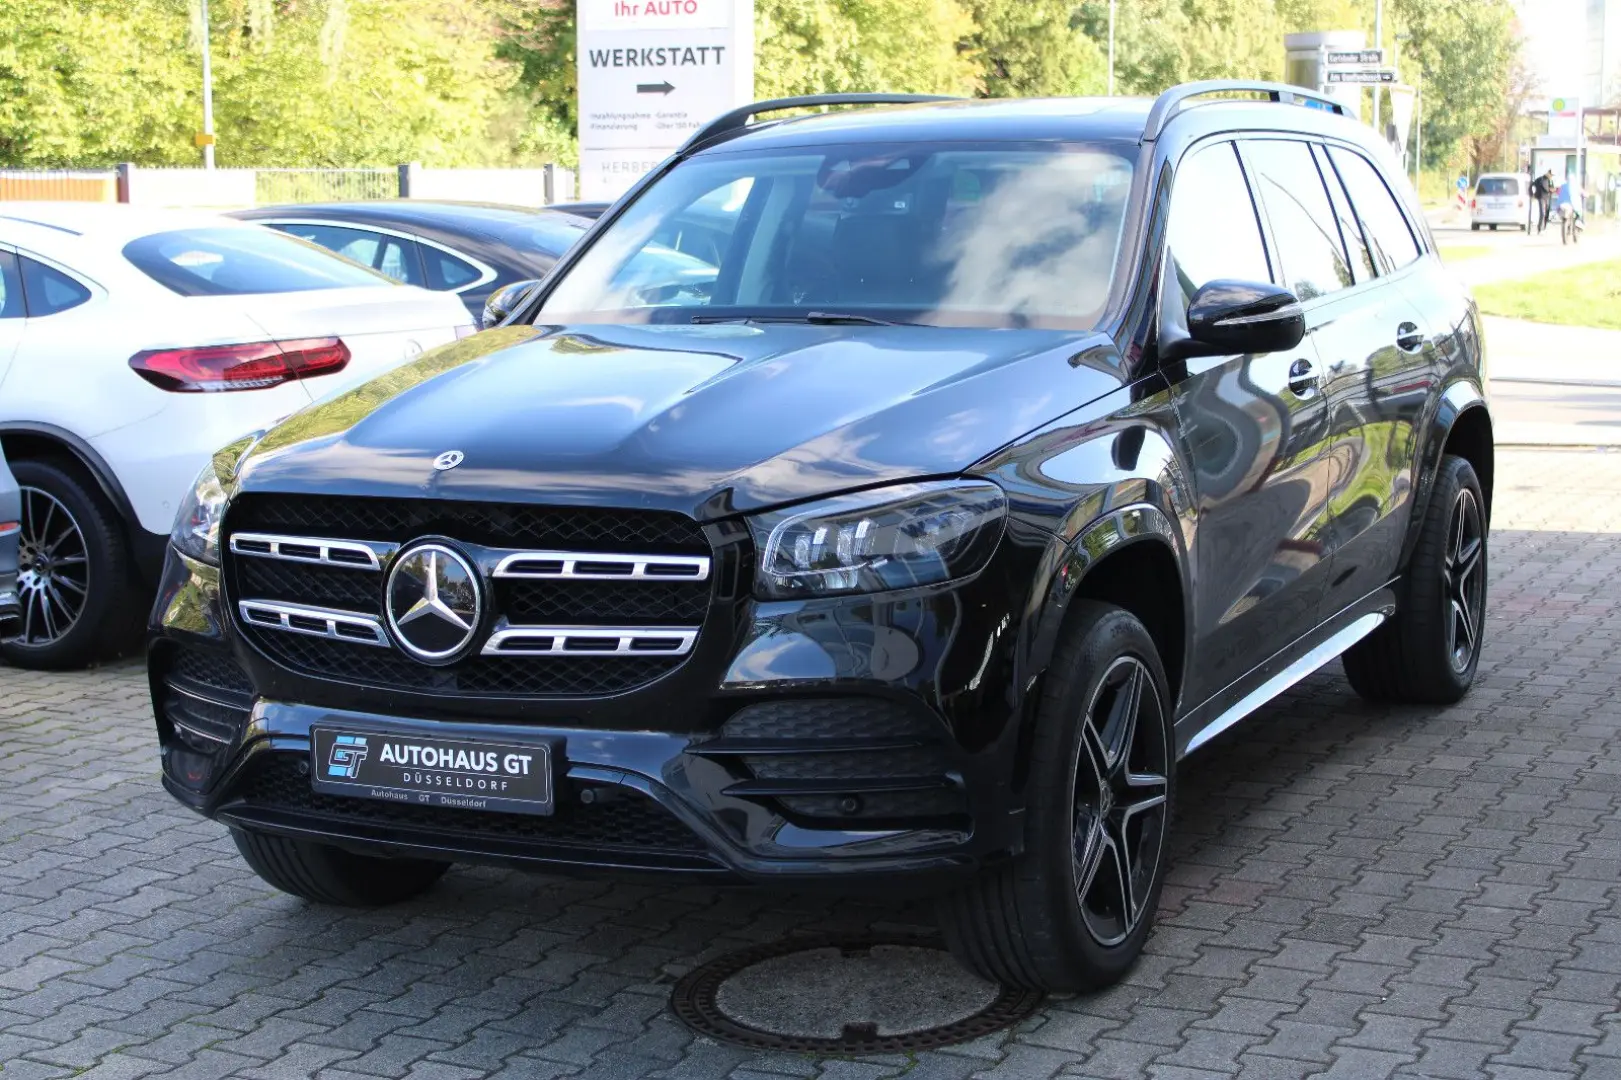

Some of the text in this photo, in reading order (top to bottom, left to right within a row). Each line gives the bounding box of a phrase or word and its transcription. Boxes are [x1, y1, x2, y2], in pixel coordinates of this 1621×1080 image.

[614, 0, 698, 17] Ihr AUTO
[589, 46, 726, 68] WERKSTATT
[380, 743, 533, 775] AUTOHAUS GT
[403, 772, 509, 791] DÜSSELDORF
[371, 789, 487, 808] Autohaus GT Düsseldorf
